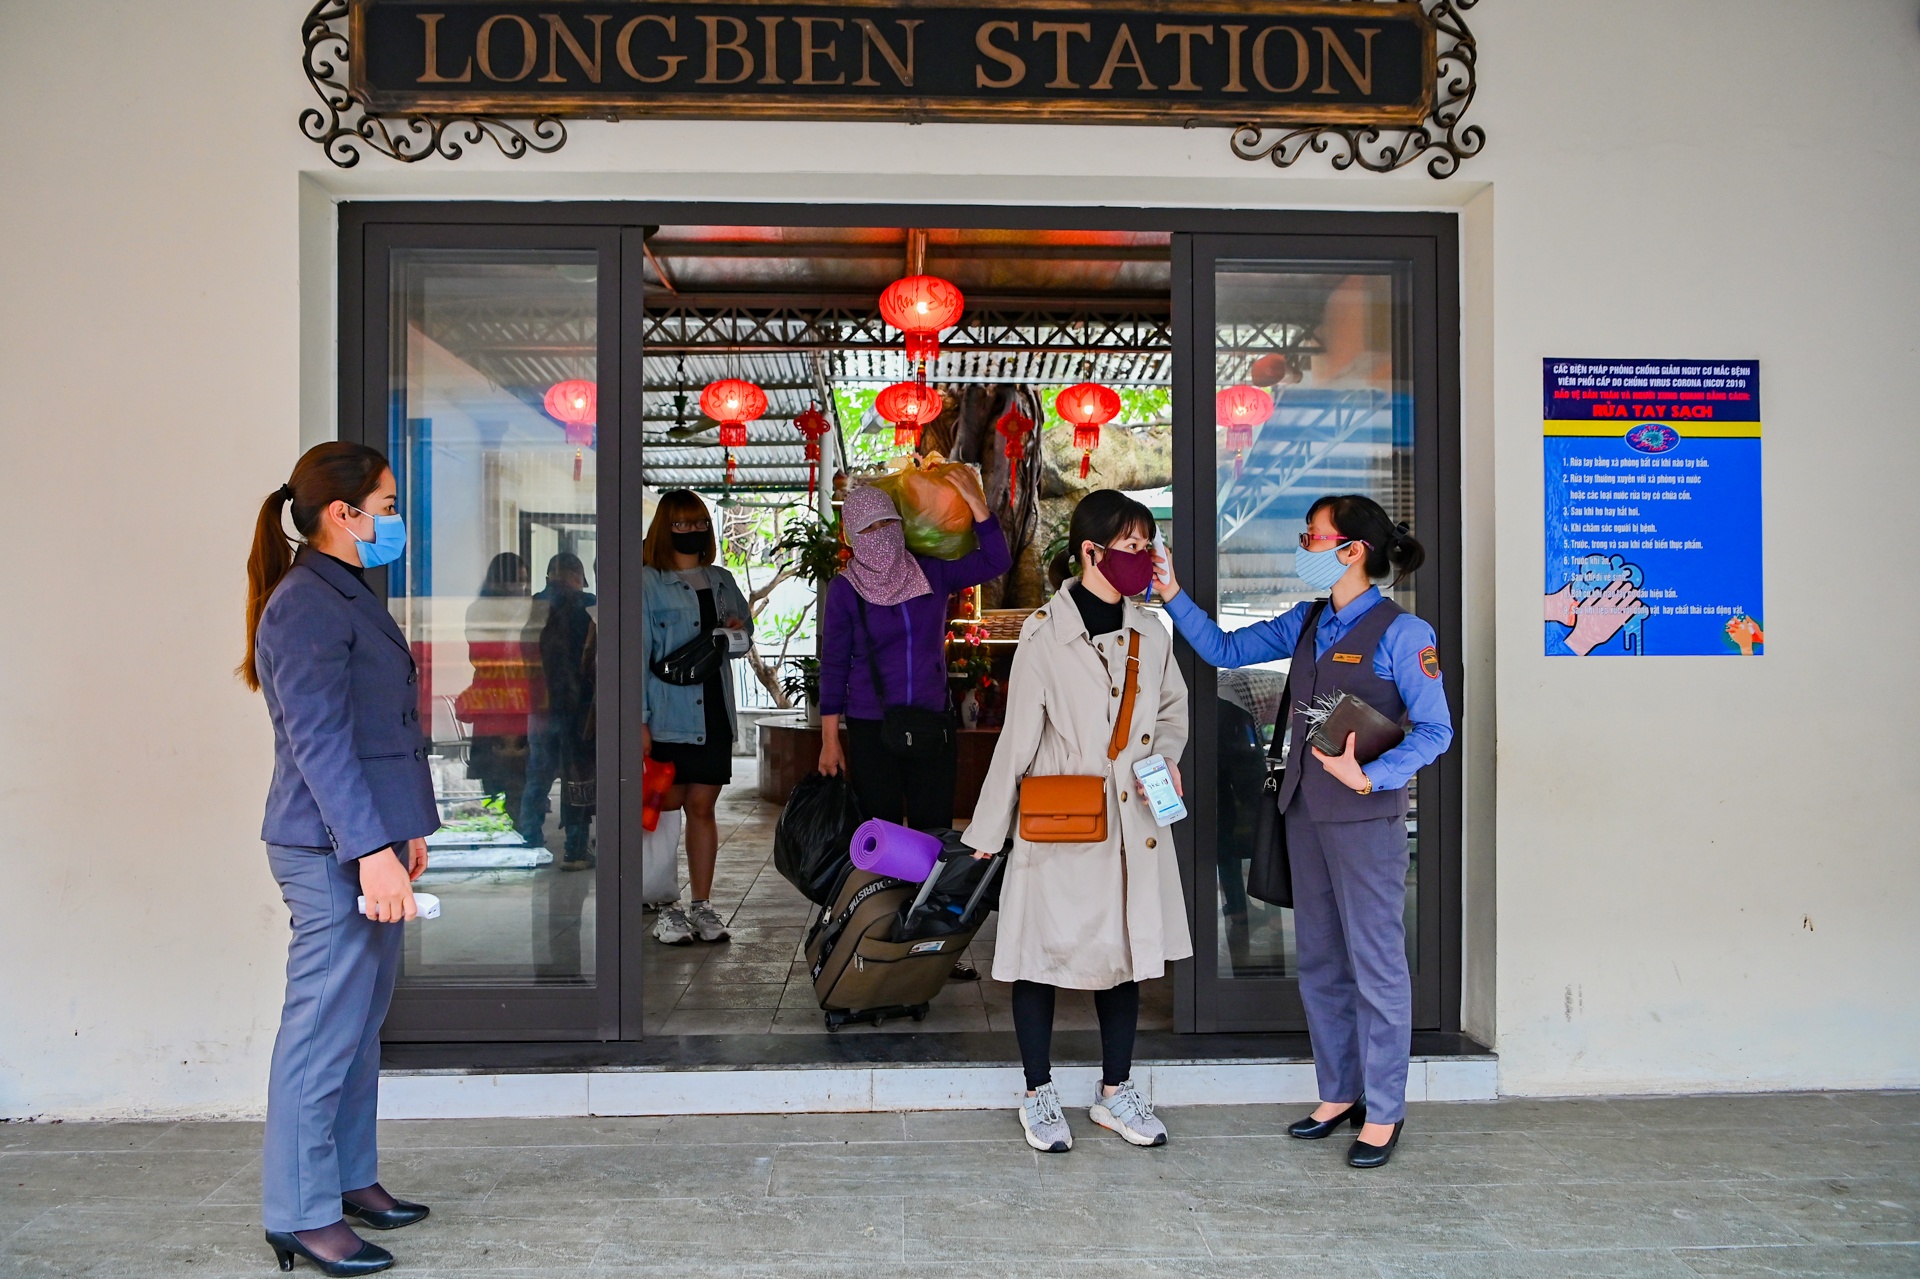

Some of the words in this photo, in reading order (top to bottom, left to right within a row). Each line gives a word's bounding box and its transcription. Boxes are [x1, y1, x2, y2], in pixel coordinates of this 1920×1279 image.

[416, 13, 924, 87] LONGBIEN
[974, 20, 1383, 95] STATION
[1554, 364, 1568, 374] CÁC
[1570, 364, 1587, 376] BIỆN
[1588, 364, 1608, 374] PHÁP
[1609, 364, 1634, 375] PHÒNG
[1635, 364, 1660, 375] CHỐNG
[1682, 366, 1701, 375] NGUY
[1702, 366, 1713, 375] CƠ
[1714, 364, 1730, 376] MẮC
[1731, 365, 1751, 377] BỆNH
[1558, 376, 1576, 386] VIÊM
[1596, 375, 1611, 386] CẤP
[1612, 378, 1622, 386] DO
[1649, 378, 1671, 387] VIRUS
[1672, 378, 1702, 387] CORONA
[1703, 379, 1725, 389] (NCOV
[1726, 379, 1746, 389] 2019)
[1593, 401, 1628, 417] RỬA
[1632, 404, 1666, 417] TAY
[1671, 405, 1713, 420] SẠCH
[1563, 458, 1569, 467] 1.
[1584, 458, 1593, 468] tay
[1594, 456, 1610, 468] bằng
[1611, 457, 1619, 467] xà
[1620, 457, 1639, 468] phòng
[1641, 456, 1651, 467] bất
[1652, 458, 1660, 467] cứ
[1661, 458, 1671, 467] khi
[1672, 458, 1684, 467] nào
[1685, 458, 1695, 468] tay
[1563, 474, 1569, 483] 2.
[1570, 473, 1582, 483] Rửa
[1584, 474, 1593, 484] tay
[1617, 474, 1636, 484] xuyên
[1648, 474, 1656, 483] xà
[1657, 474, 1676, 485] phòng
[1677, 474, 1685, 483] và
[1570, 490, 1586, 501] hoặc
[1587, 490, 1599, 500] các
[1600, 490, 1612, 501] loại
[1630, 490, 1640, 500] rửa
[1642, 491, 1652, 501] tay
[1652, 491, 1660, 500] có
[1563, 507, 1569, 516] 3.
[1571, 507, 1582, 516] Sau
[1584, 507, 1594, 516] khi
[1595, 507, 1603, 516] ho
[1604, 507, 1616, 517] hay
[1563, 523, 1569, 532] 4.
[1571, 524, 1581, 532] Khi
[1582, 523, 1600, 532] chăm
[1601, 523, 1613, 532] sóc
[1632, 523, 1639, 534] bị
[1640, 523, 1657, 534] bệnh.
[1564, 540, 1570, 549] 5.
[1591, 540, 1608, 550] trong
[1609, 540, 1617, 549] và
[1630, 540, 1640, 549] khi
[1642, 538, 1654, 549] chế
[1654, 538, 1668, 549] biến
[1564, 556, 1570, 565] 6.
[1590, 556, 1600, 565] khi
[1564, 573, 1570, 582] 7.
[1571, 573, 1583, 582] Sau
[1650, 589, 1664, 600] hiệu
[1663, 606, 1674, 615] hay
[1675, 604, 1689, 614] chất
[1690, 604, 1702, 614] thải
[1716, 605, 1732, 616] động
